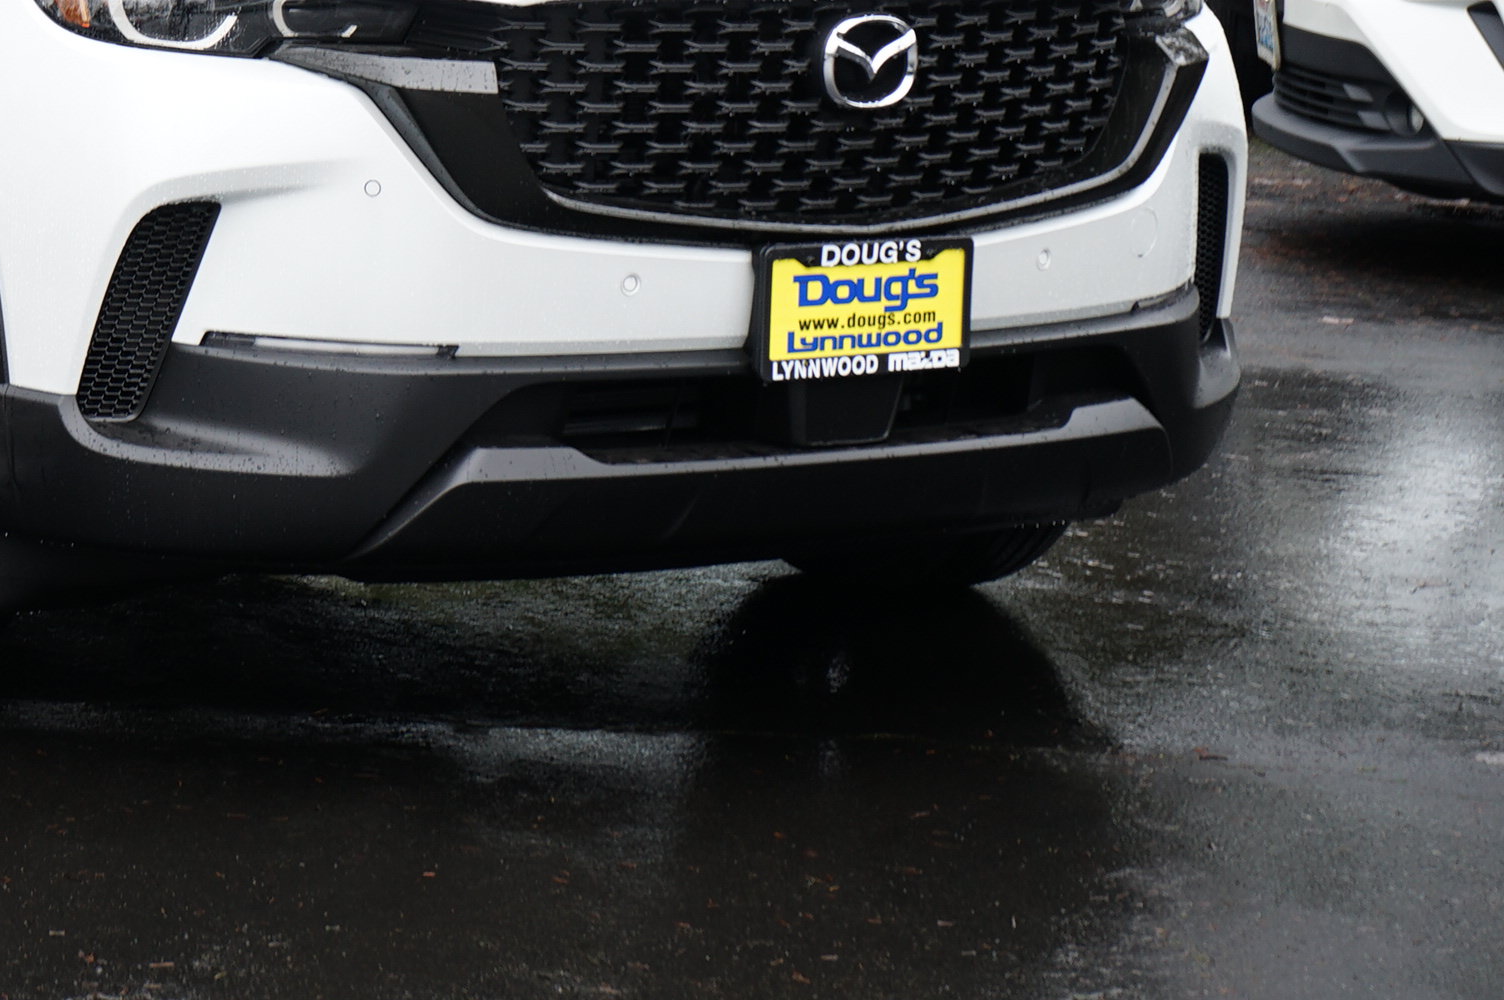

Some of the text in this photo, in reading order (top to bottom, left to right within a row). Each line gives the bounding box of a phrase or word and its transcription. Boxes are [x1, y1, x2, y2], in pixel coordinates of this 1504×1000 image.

[821, 239, 922, 267] DOUG'S
[793, 268, 939, 312] Doug's
[799, 310, 936, 331] www.dougs.com
[787, 322, 943, 353] Lynnwood
[772, 354, 879, 382] LYNNWOOD
